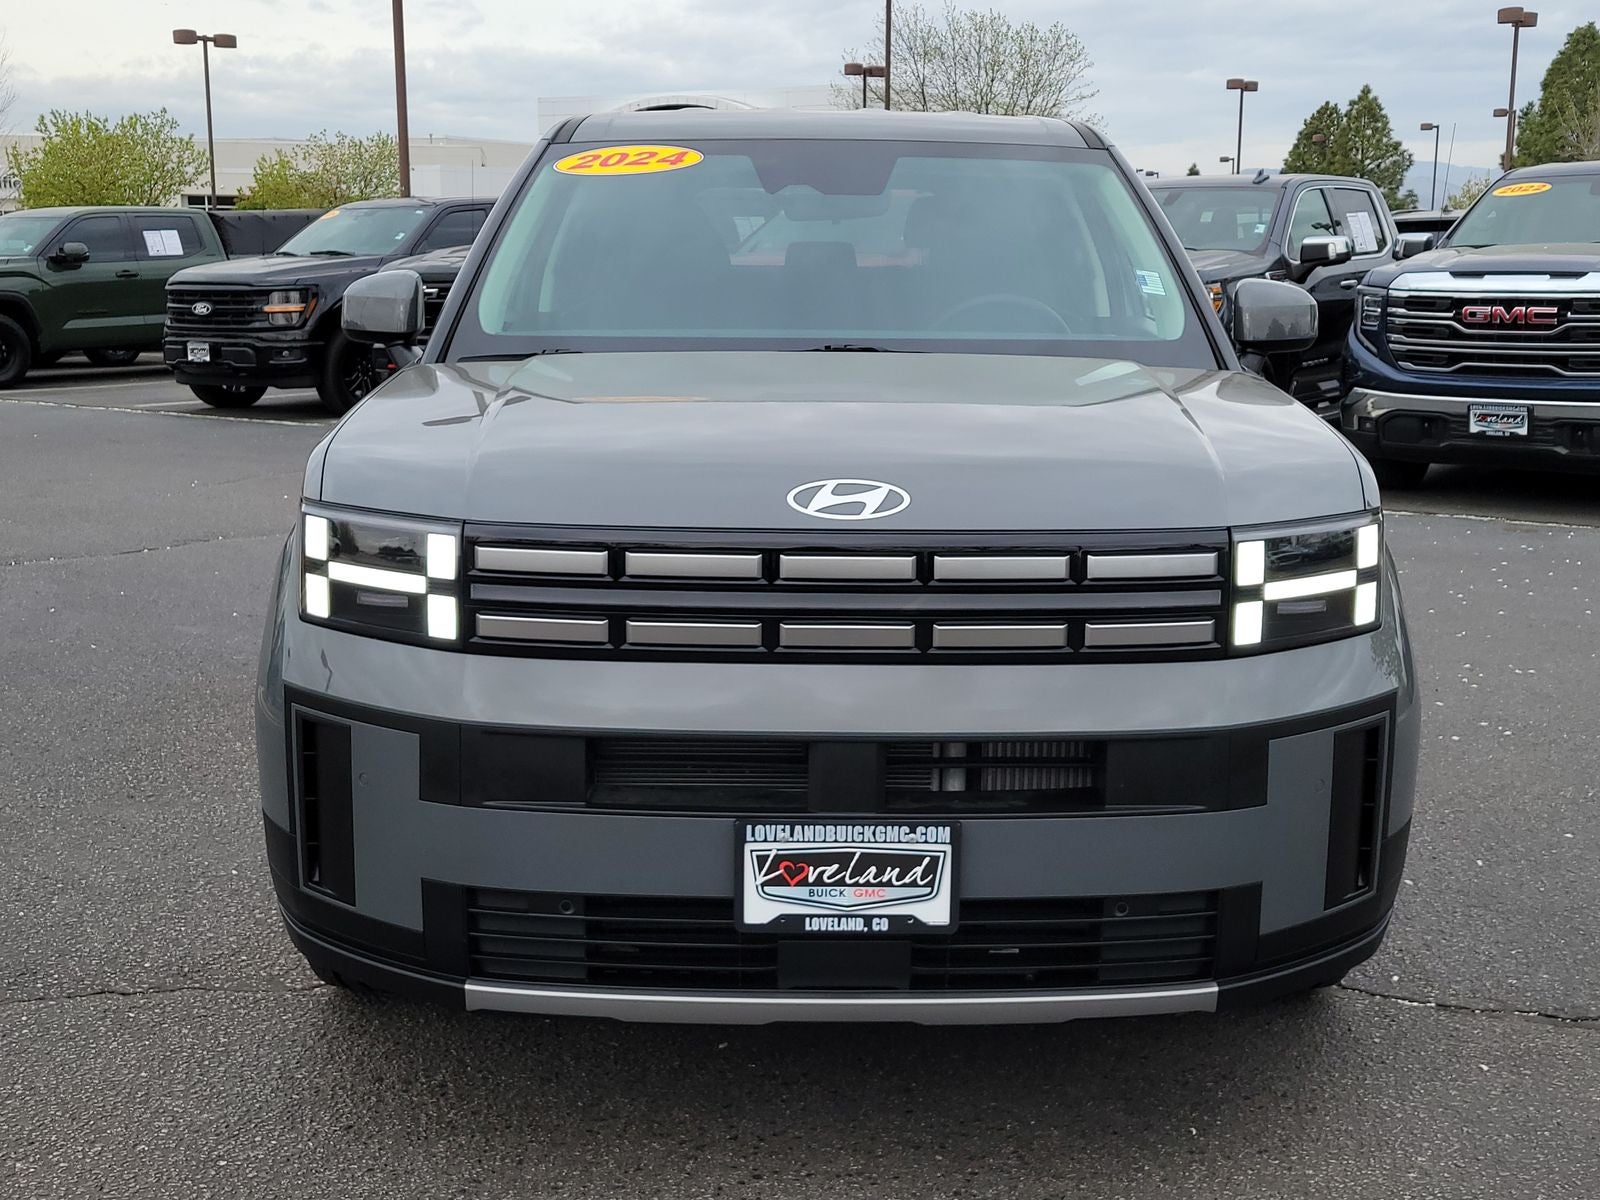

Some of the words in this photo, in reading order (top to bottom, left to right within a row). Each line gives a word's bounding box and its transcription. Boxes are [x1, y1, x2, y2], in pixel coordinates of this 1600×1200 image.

[566, 151, 691, 170] 2024
[1462, 306, 1558, 324] GMC
[746, 825, 950, 844] LOVELANDBUICKGMC.COM
[808, 888, 846, 898] BUICK
[853, 888, 886, 898] GMC
[805, 917, 868, 932] LOVELAND,
[872, 917, 889, 931] CO
